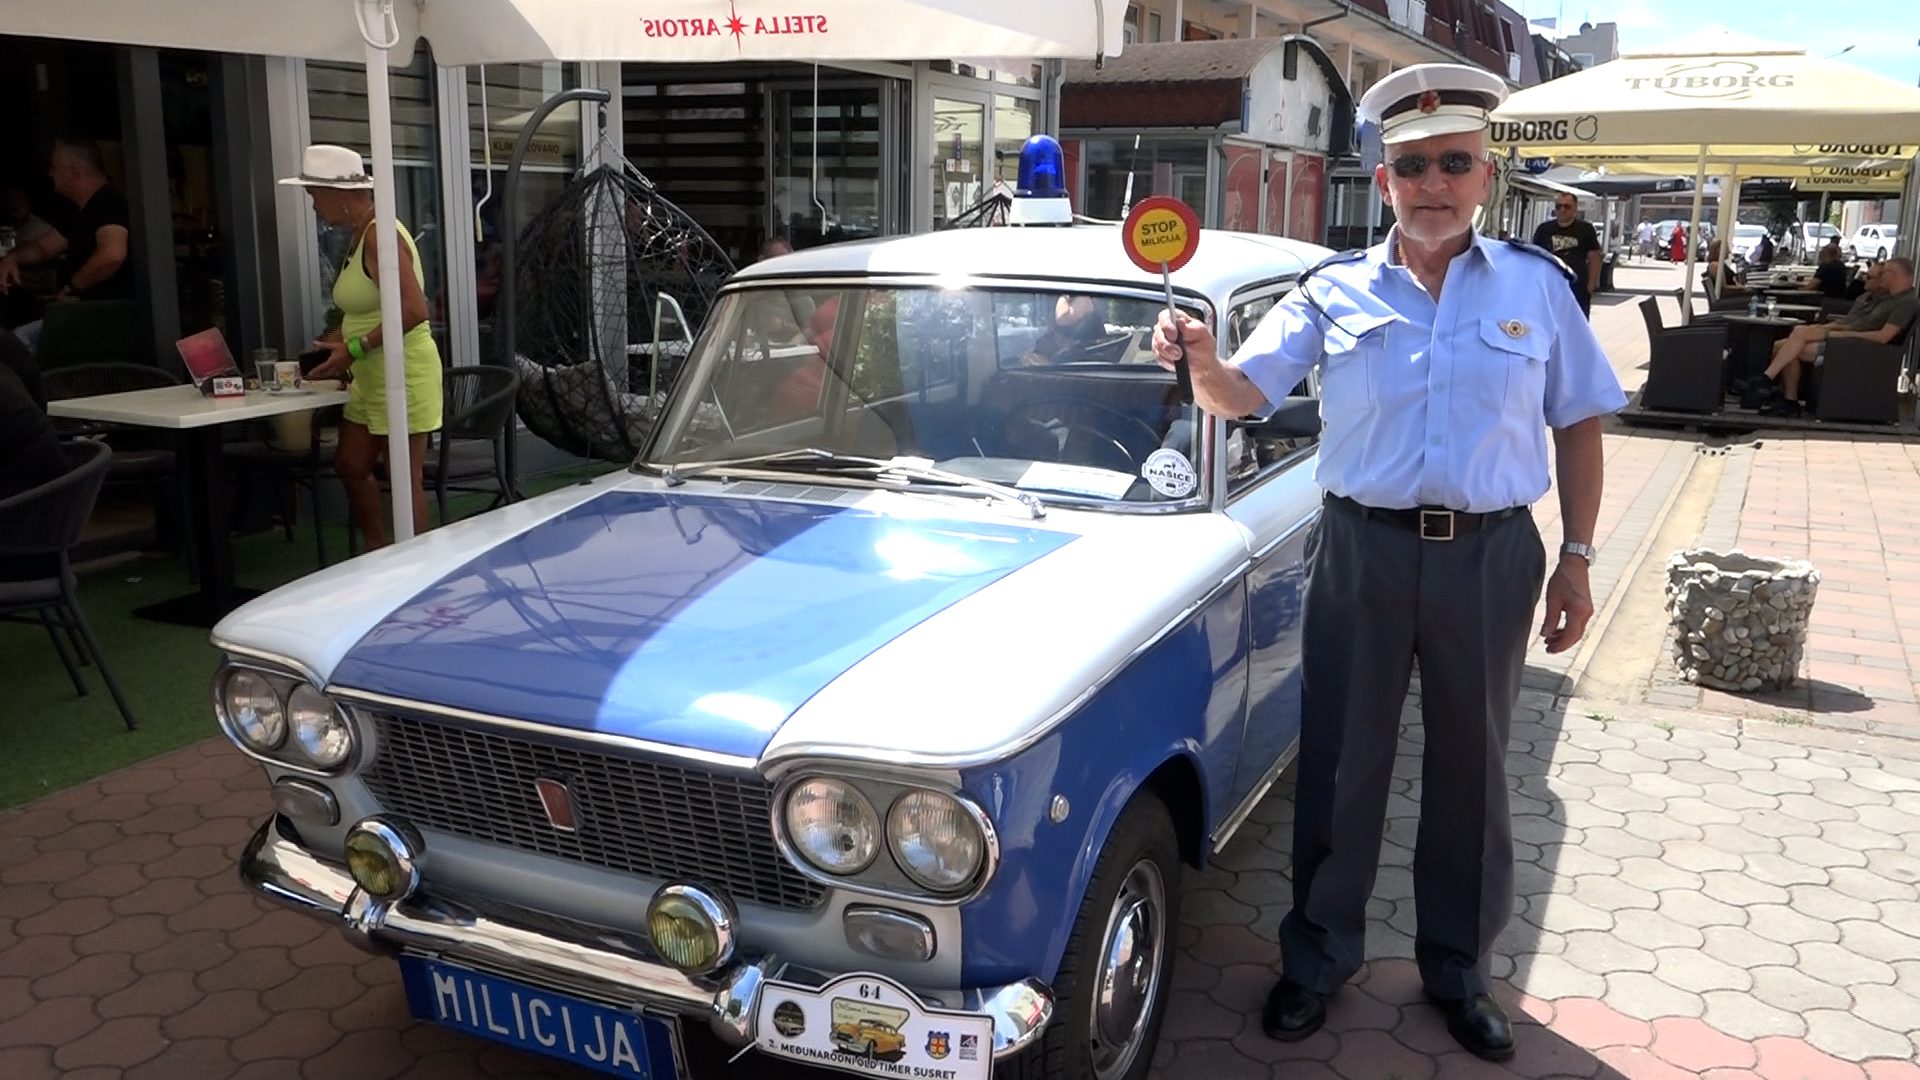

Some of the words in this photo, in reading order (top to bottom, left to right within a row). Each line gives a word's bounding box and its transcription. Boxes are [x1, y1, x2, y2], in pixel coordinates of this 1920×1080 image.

[1625, 75, 1795, 90] TUBORG
[1490, 119, 1568, 142] UBORG
[1141, 220, 1178, 236] STOP
[1141, 234, 1182, 247] MILICIJA
[859, 983, 881, 1001] 64
[432, 971, 641, 1073] MILICIJA
[856, 1056, 877, 1070] OLD
[878, 1061, 911, 1075] TIMER
[913, 1067, 957, 1080] SUSRET
